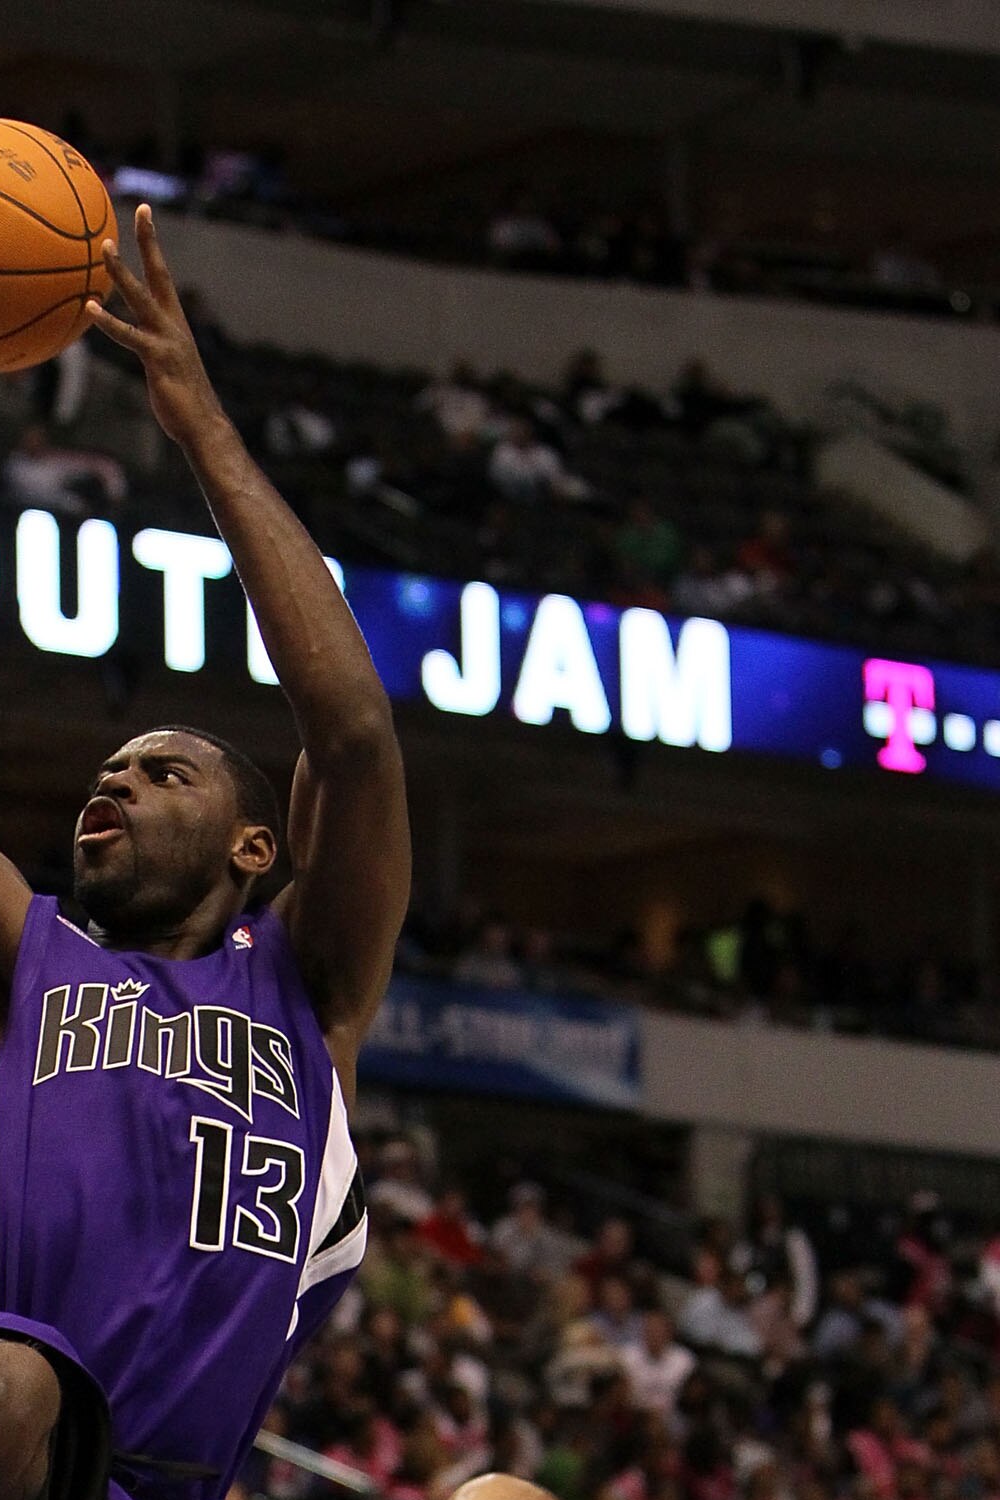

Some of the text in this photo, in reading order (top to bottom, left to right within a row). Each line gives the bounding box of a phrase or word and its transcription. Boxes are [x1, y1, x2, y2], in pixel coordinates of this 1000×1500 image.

[421, 581, 732, 753] JAM
[33, 978, 301, 1124] Kings
[189, 1115, 304, 1264] 13
